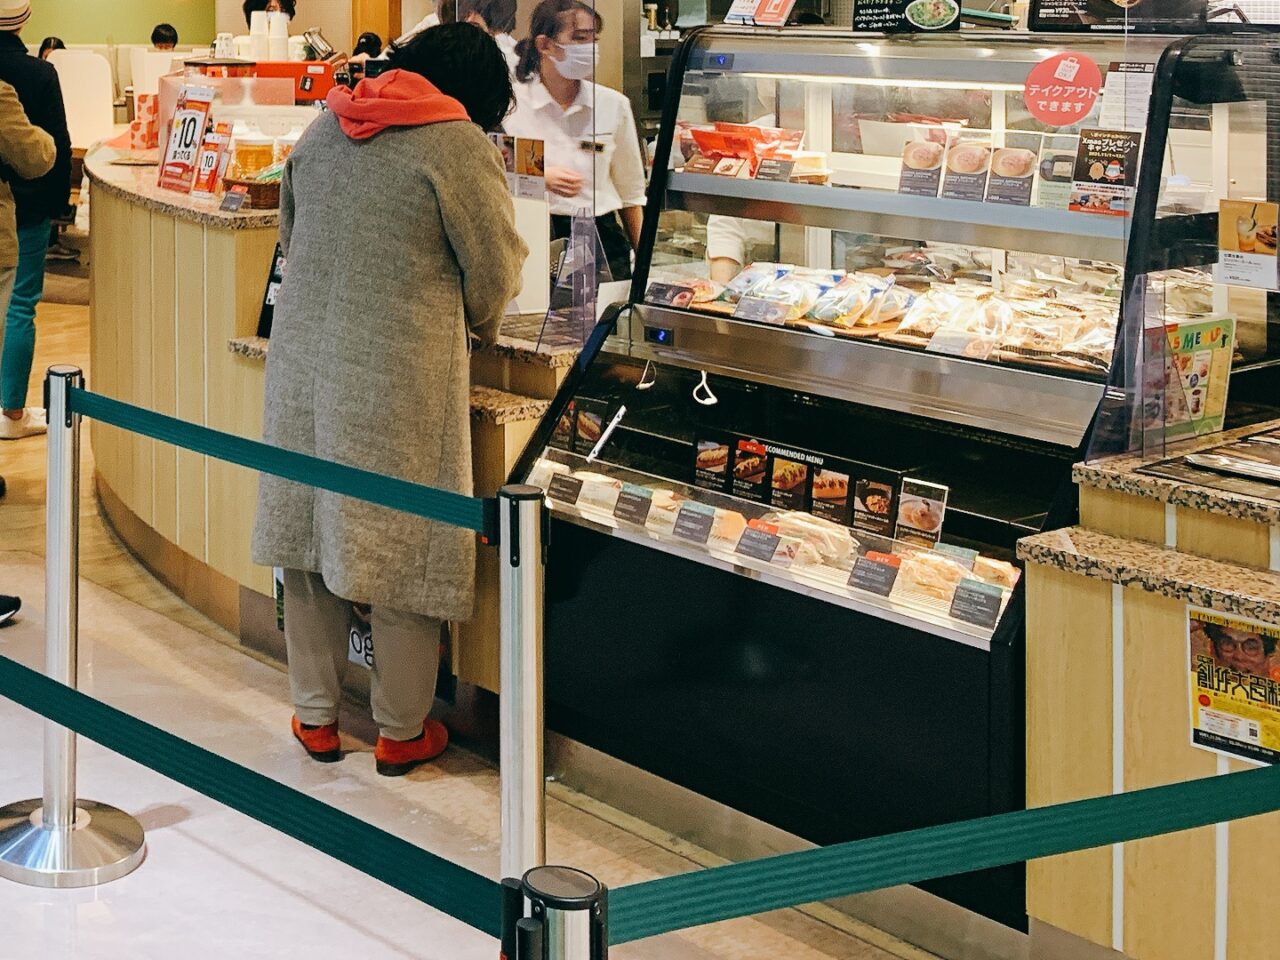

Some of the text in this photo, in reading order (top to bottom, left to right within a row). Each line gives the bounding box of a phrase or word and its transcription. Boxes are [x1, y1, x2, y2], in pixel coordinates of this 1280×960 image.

[1029, 84, 1098, 99] テイクアウト
[1037, 100, 1085, 113] できます
[1082, 137, 1137, 148] Xmasプレゼント
[1087, 144, 1131, 153] キャンペーン
[763, 443, 824, 465] ECOMMENDED MENU
